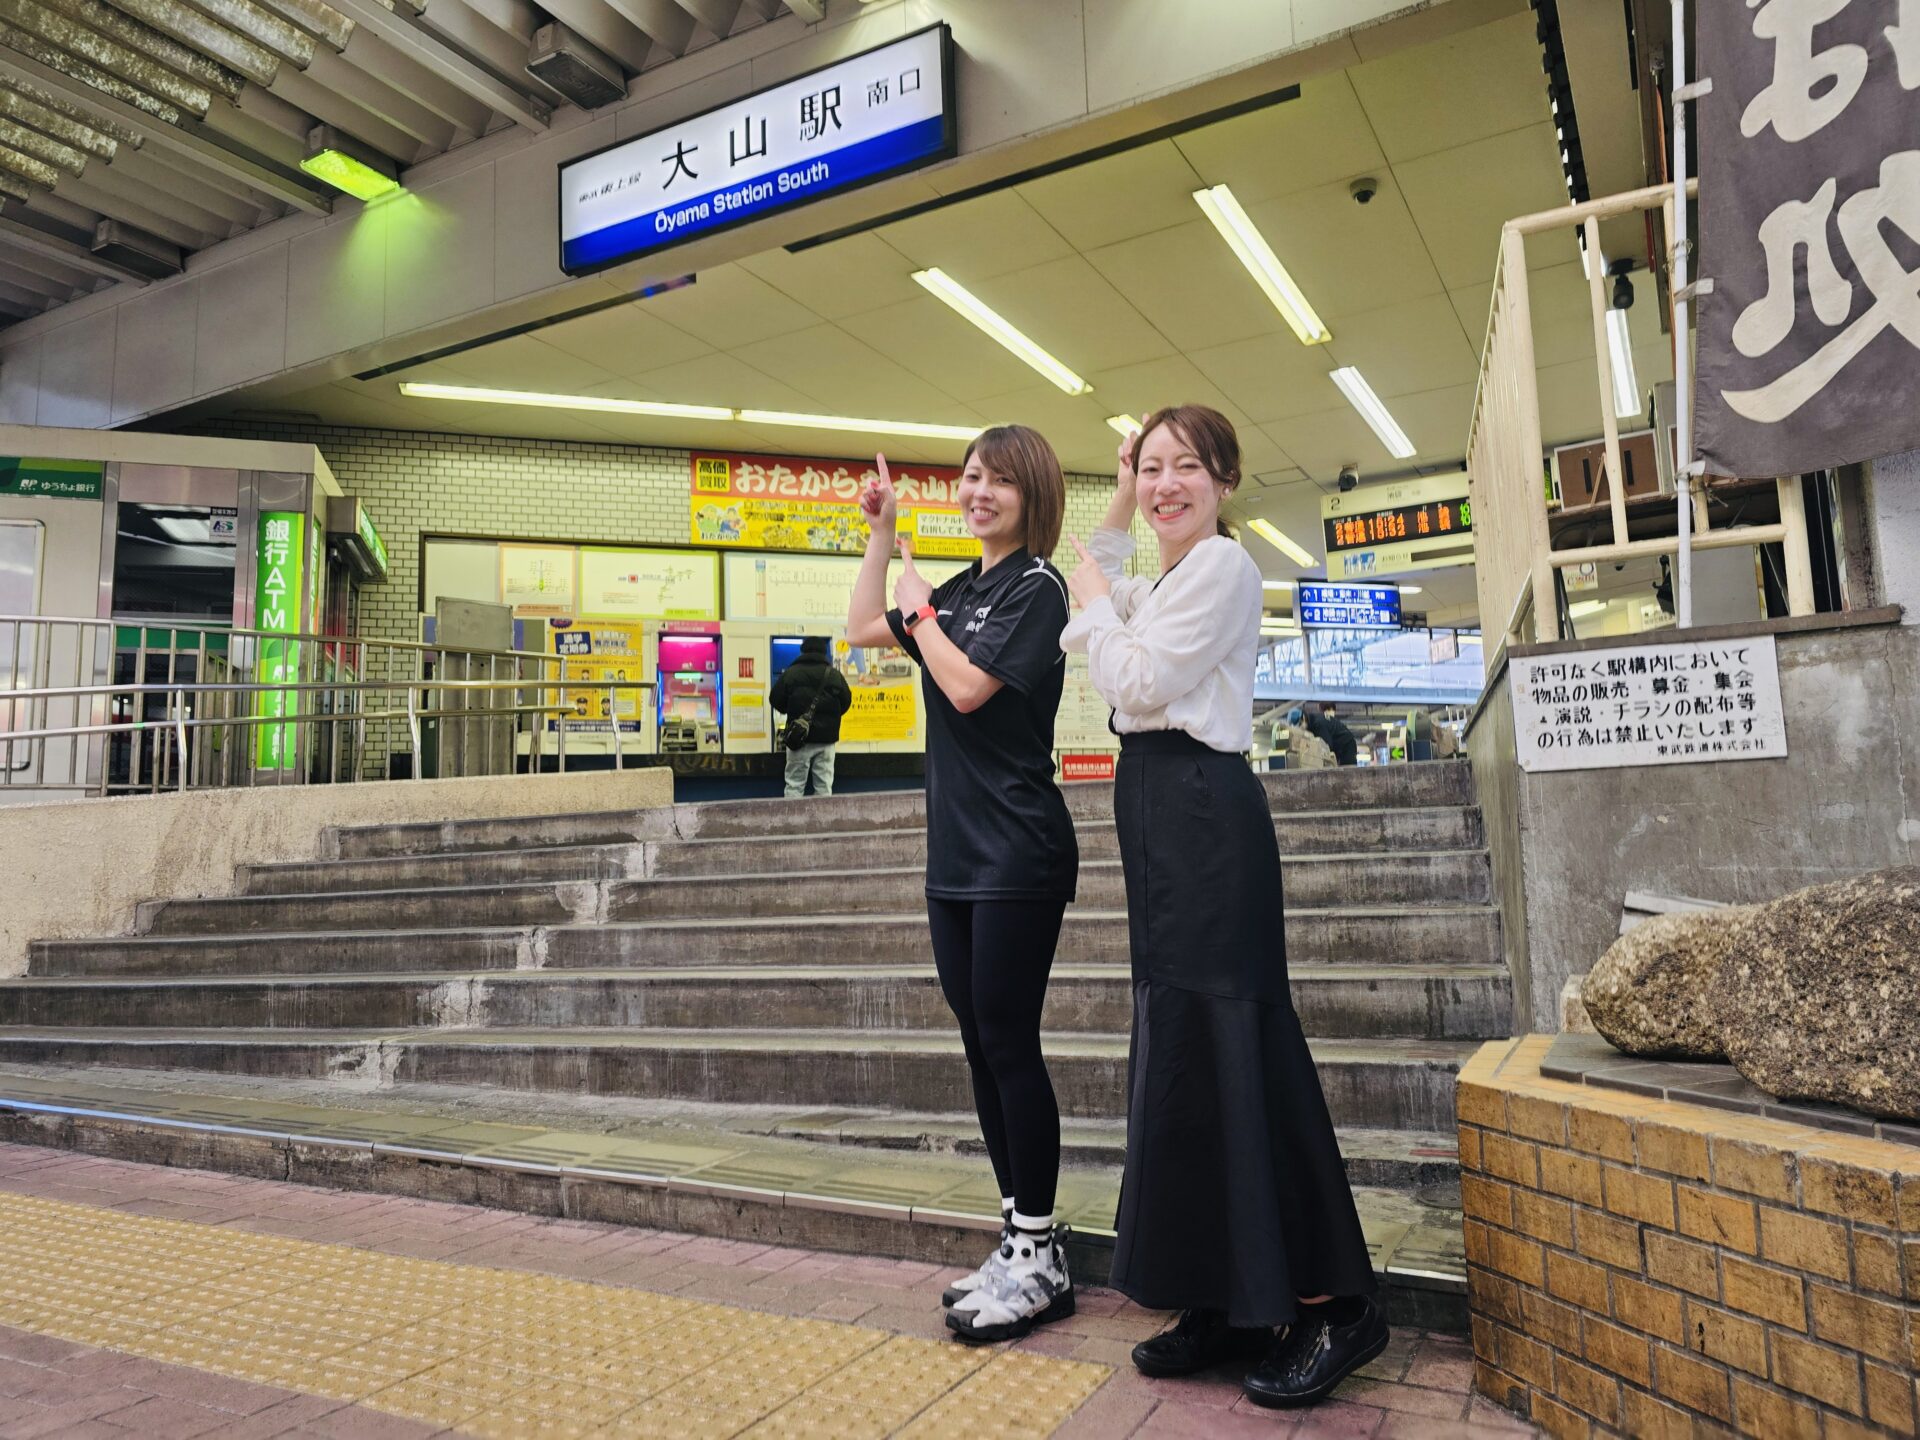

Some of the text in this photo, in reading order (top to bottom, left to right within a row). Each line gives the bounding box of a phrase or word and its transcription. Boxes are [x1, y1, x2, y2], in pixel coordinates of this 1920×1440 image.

[661, 67, 921, 190] 大山駅 南口
[713, 181, 774, 214] Station
[778, 161, 829, 193] South
[698, 460, 728, 475] 高価
[41, 481, 96, 493] ゆうちょ銀行
[699, 475, 728, 489] 買取
[1330, 498, 1341, 512] 2
[262, 519, 290, 629] 銀行ATM
[1530, 647, 1751, 684] 許可なく駅構内において
[1537, 717, 1758, 749] の行為は禁止いたします
[1657, 739, 1766, 756] 東武鉄道株式会社
